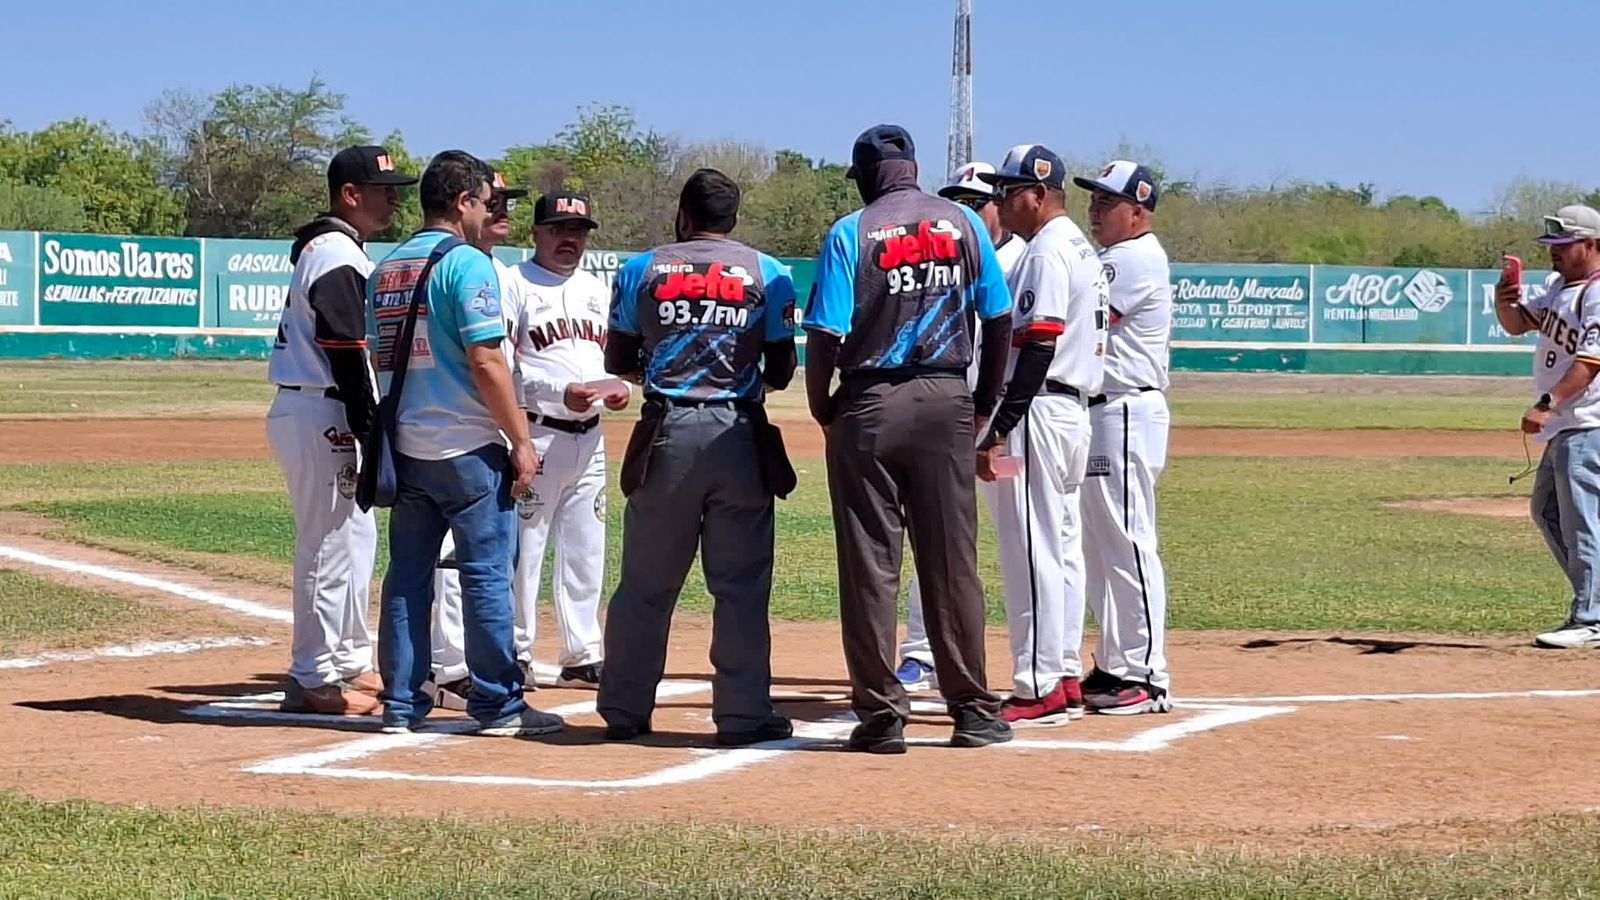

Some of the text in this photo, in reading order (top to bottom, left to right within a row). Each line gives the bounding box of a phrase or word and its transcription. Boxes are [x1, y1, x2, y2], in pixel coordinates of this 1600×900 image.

[44, 239, 121, 277] Somos
[1178, 278, 1240, 300] Rolando
[1228, 278, 1304, 304] Mercado
[1325, 273, 1403, 306] ABC
[1545, 350, 1556, 368] 8
